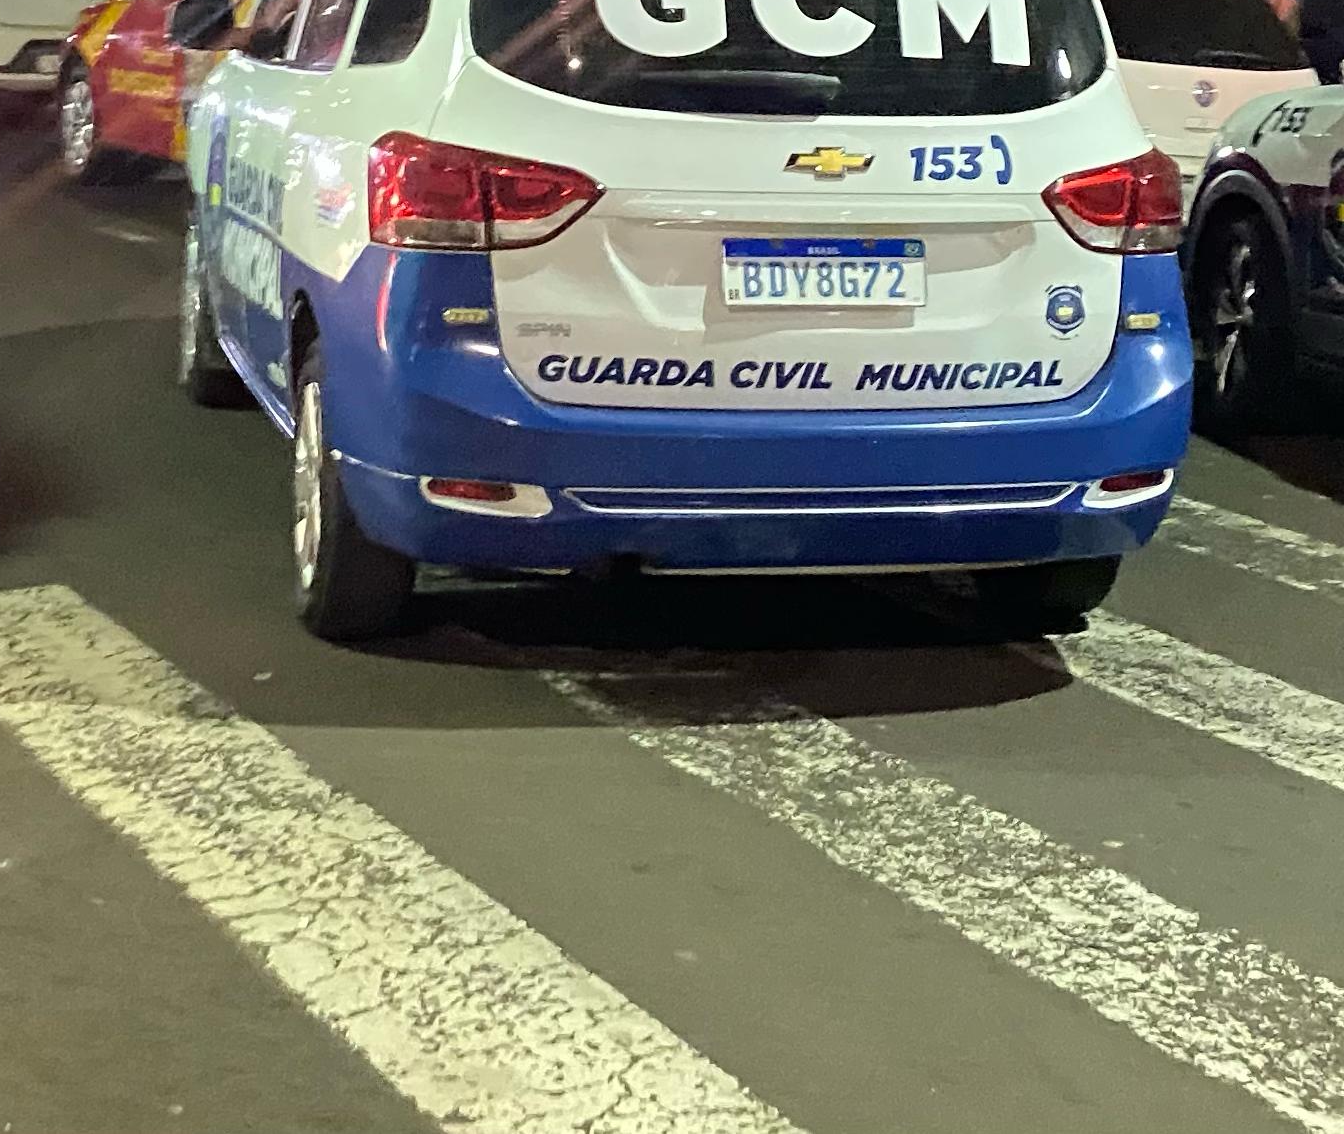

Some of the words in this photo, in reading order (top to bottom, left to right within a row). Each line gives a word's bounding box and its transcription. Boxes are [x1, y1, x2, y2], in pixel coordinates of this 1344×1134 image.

[909, 146, 983, 182] 153
[743, 261, 906, 298] BDY8G72
[537, 354, 716, 388] GUARDA
[729, 360, 833, 389] CIVIL
[855, 360, 1063, 391] MUNICIPAL
